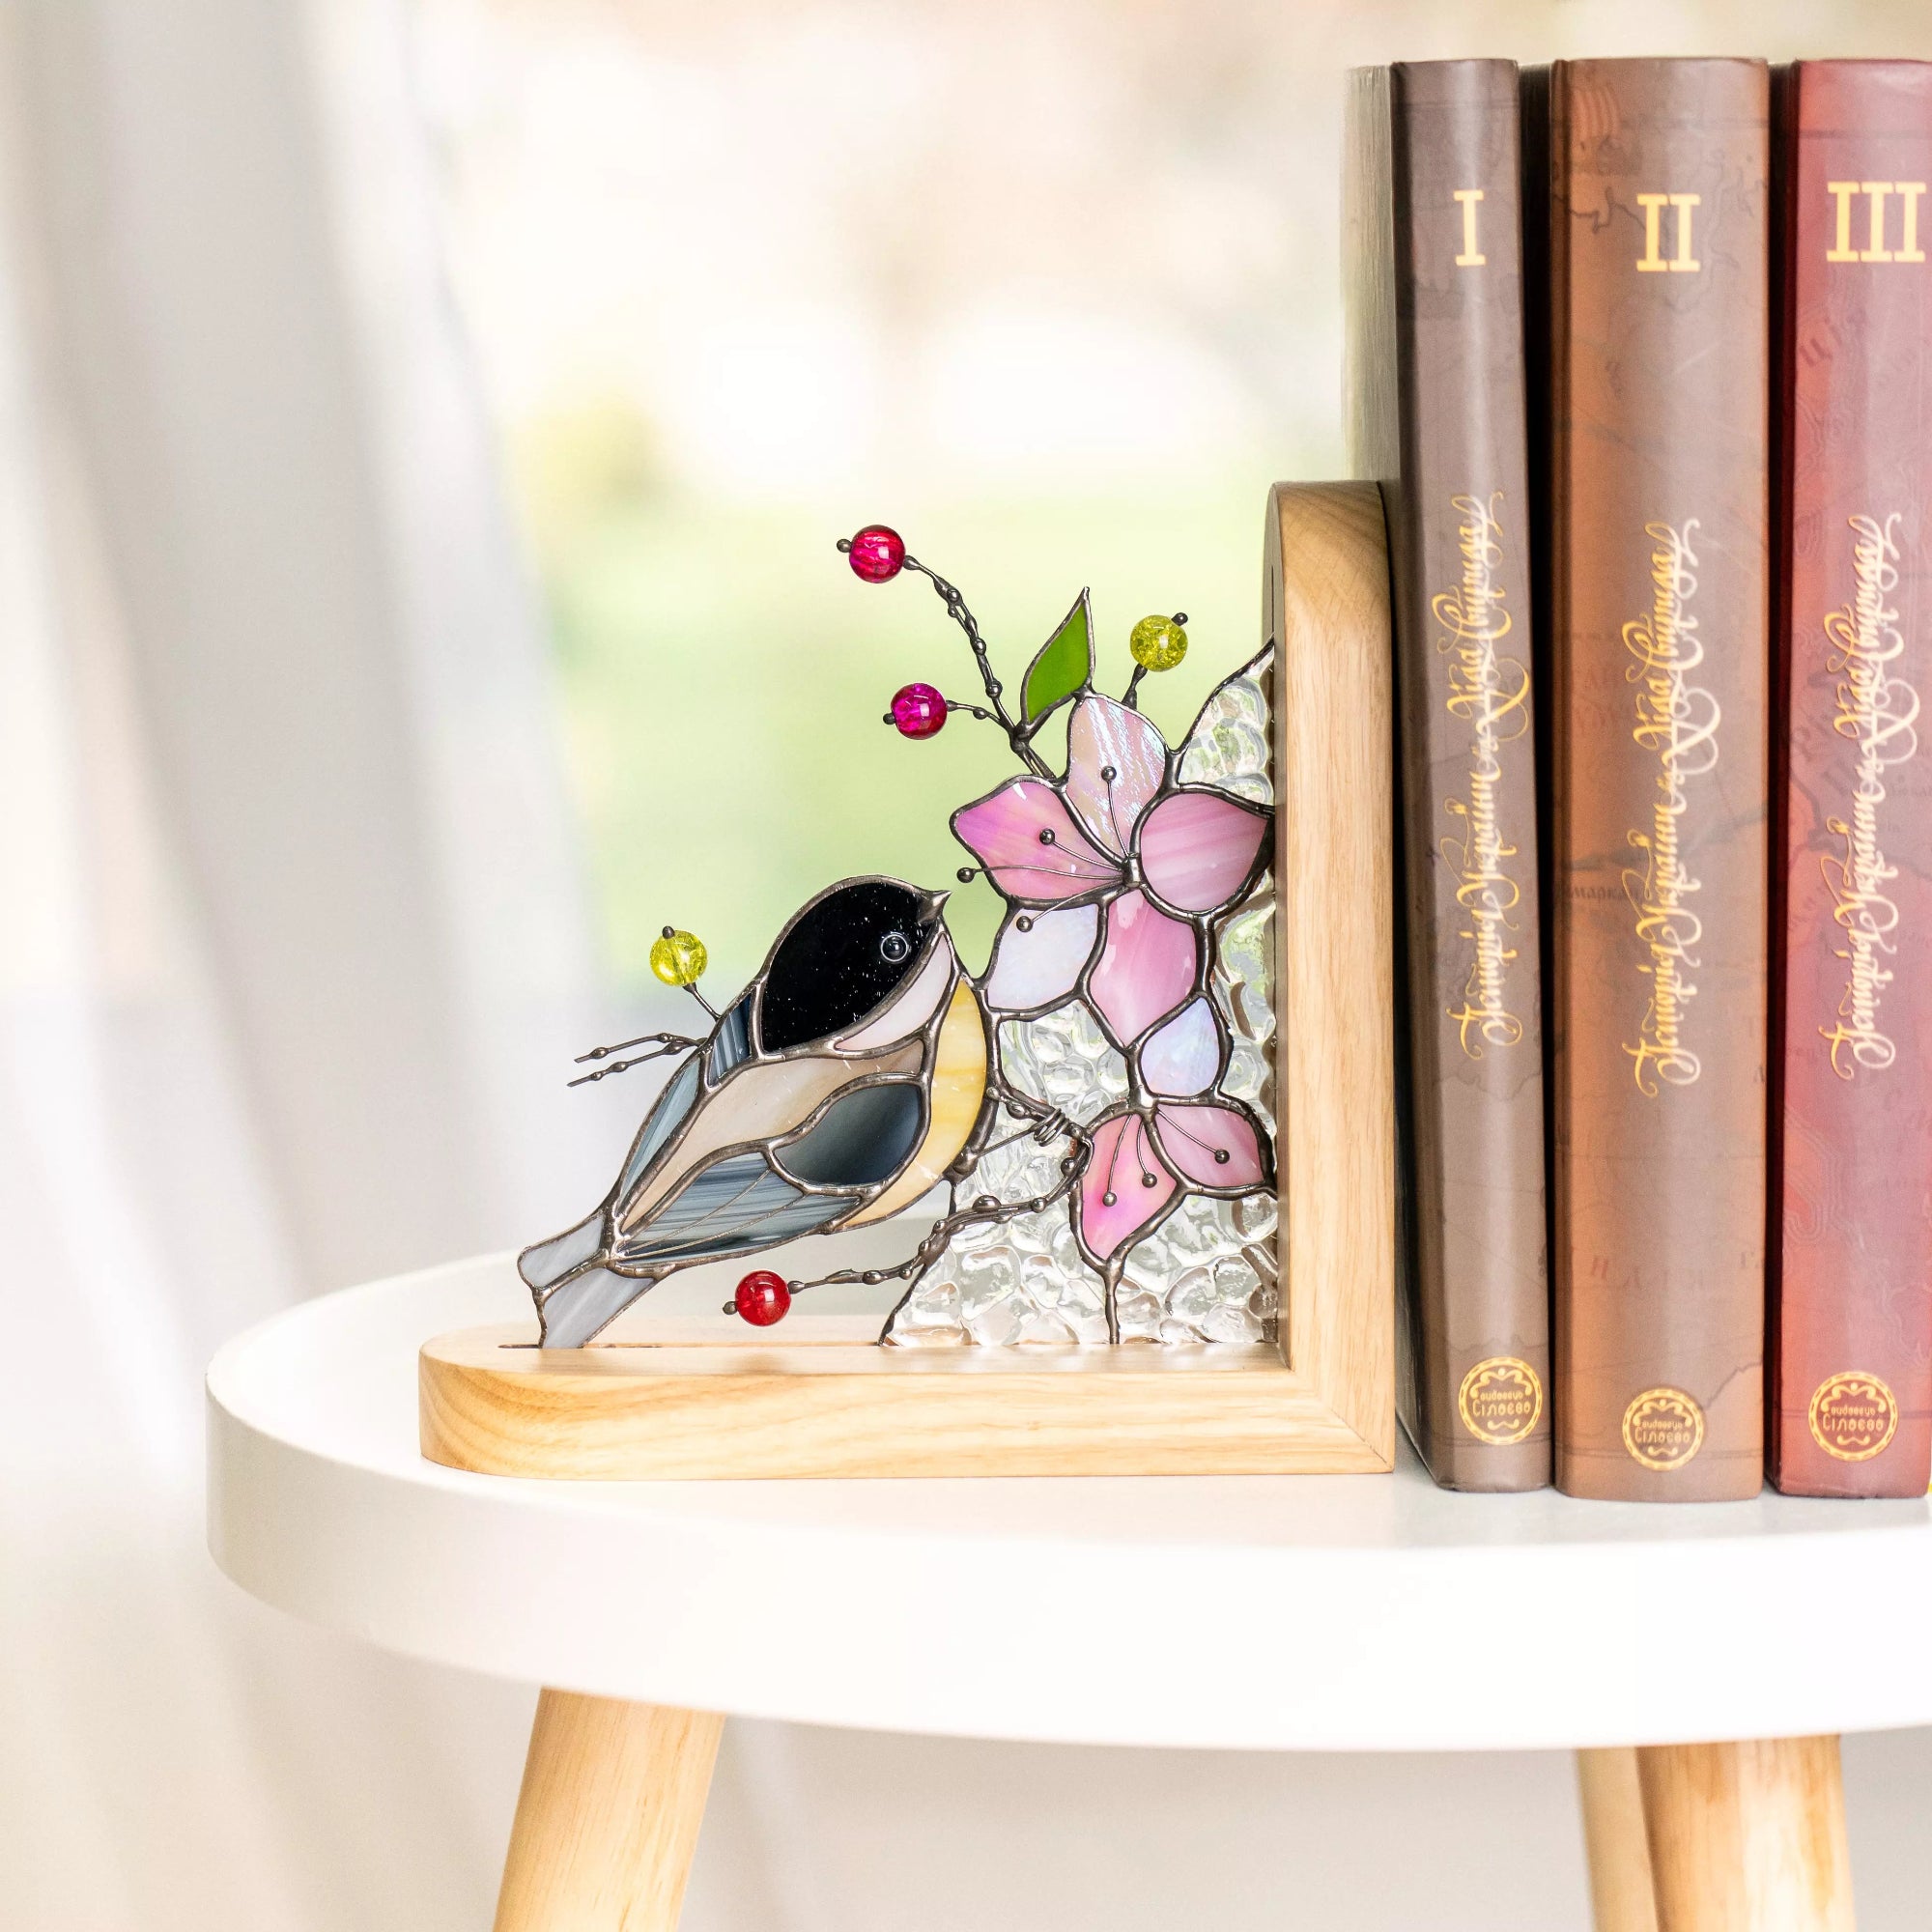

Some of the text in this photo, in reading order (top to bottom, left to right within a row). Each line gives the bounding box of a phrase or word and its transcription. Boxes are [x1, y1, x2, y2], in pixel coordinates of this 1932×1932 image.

[1454, 190, 1486, 266] I
[1636, 194, 1700, 271] II
[1827, 182, 1926, 262] III
[1440, 765, 1520, 908] України
[1622, 798, 1701, 944] України
[1819, 786, 1898, 932] України
[1445, 907, 1522, 1059] Історія
[1622, 942, 1700, 1098] Історія
[1817, 928, 1894, 1080] Історія
